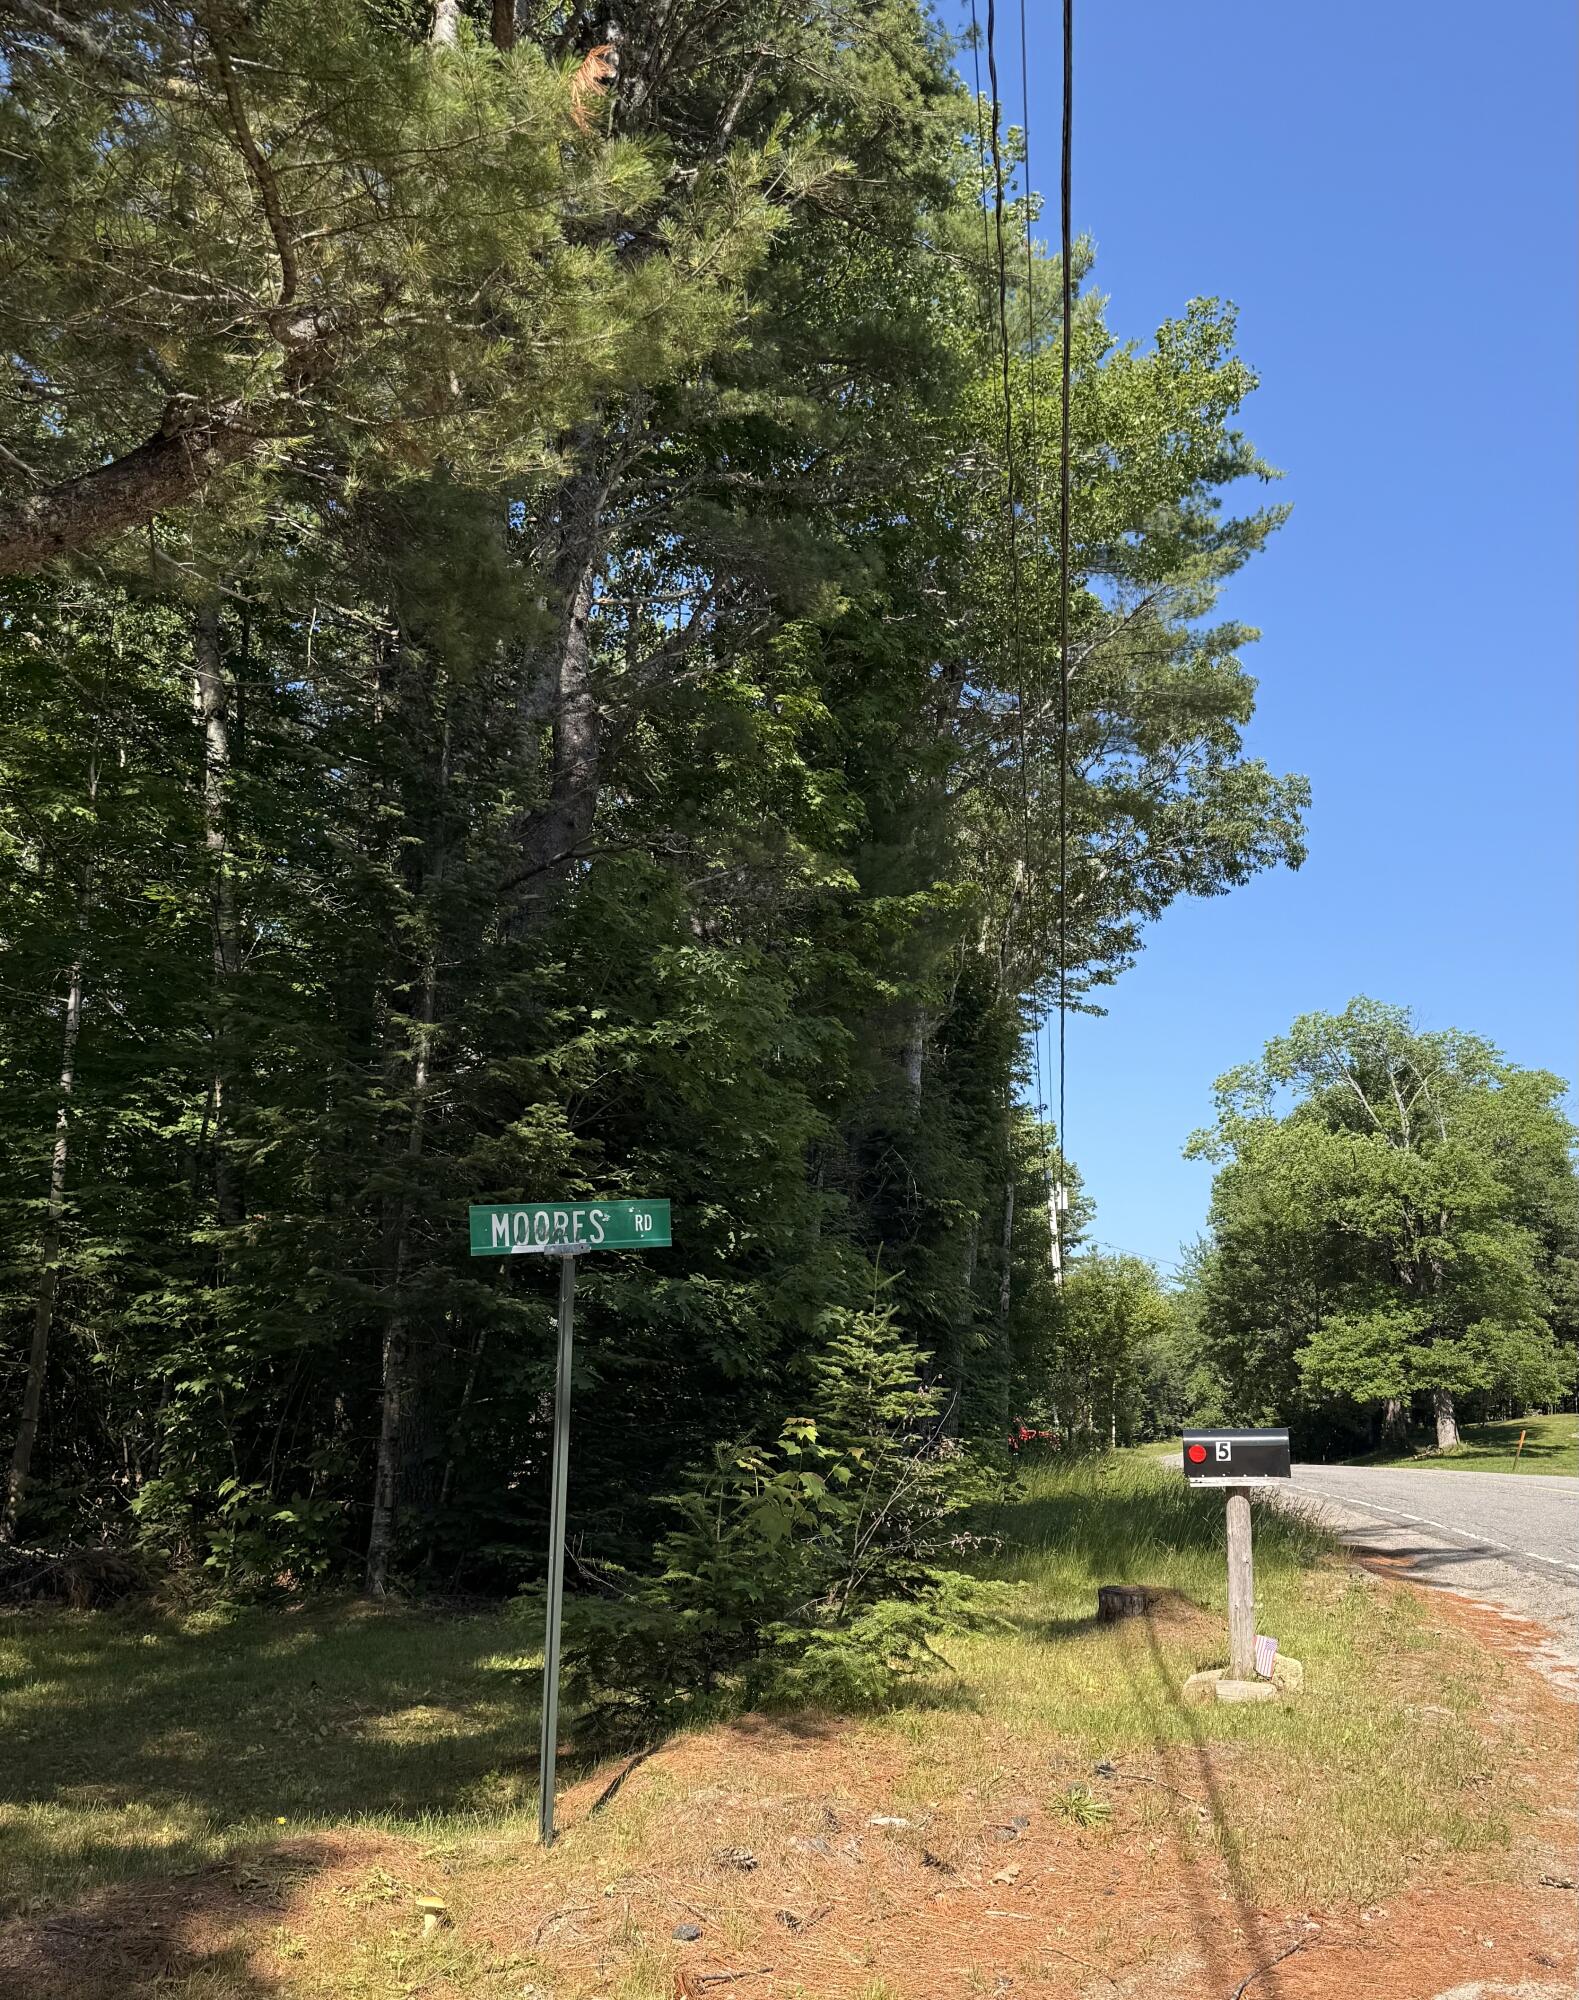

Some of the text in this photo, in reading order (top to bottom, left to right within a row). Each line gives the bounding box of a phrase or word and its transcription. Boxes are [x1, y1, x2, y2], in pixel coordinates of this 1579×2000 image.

[491, 1209, 652, 1247] MOORES RD
[1218, 1443, 1229, 1460] 5
